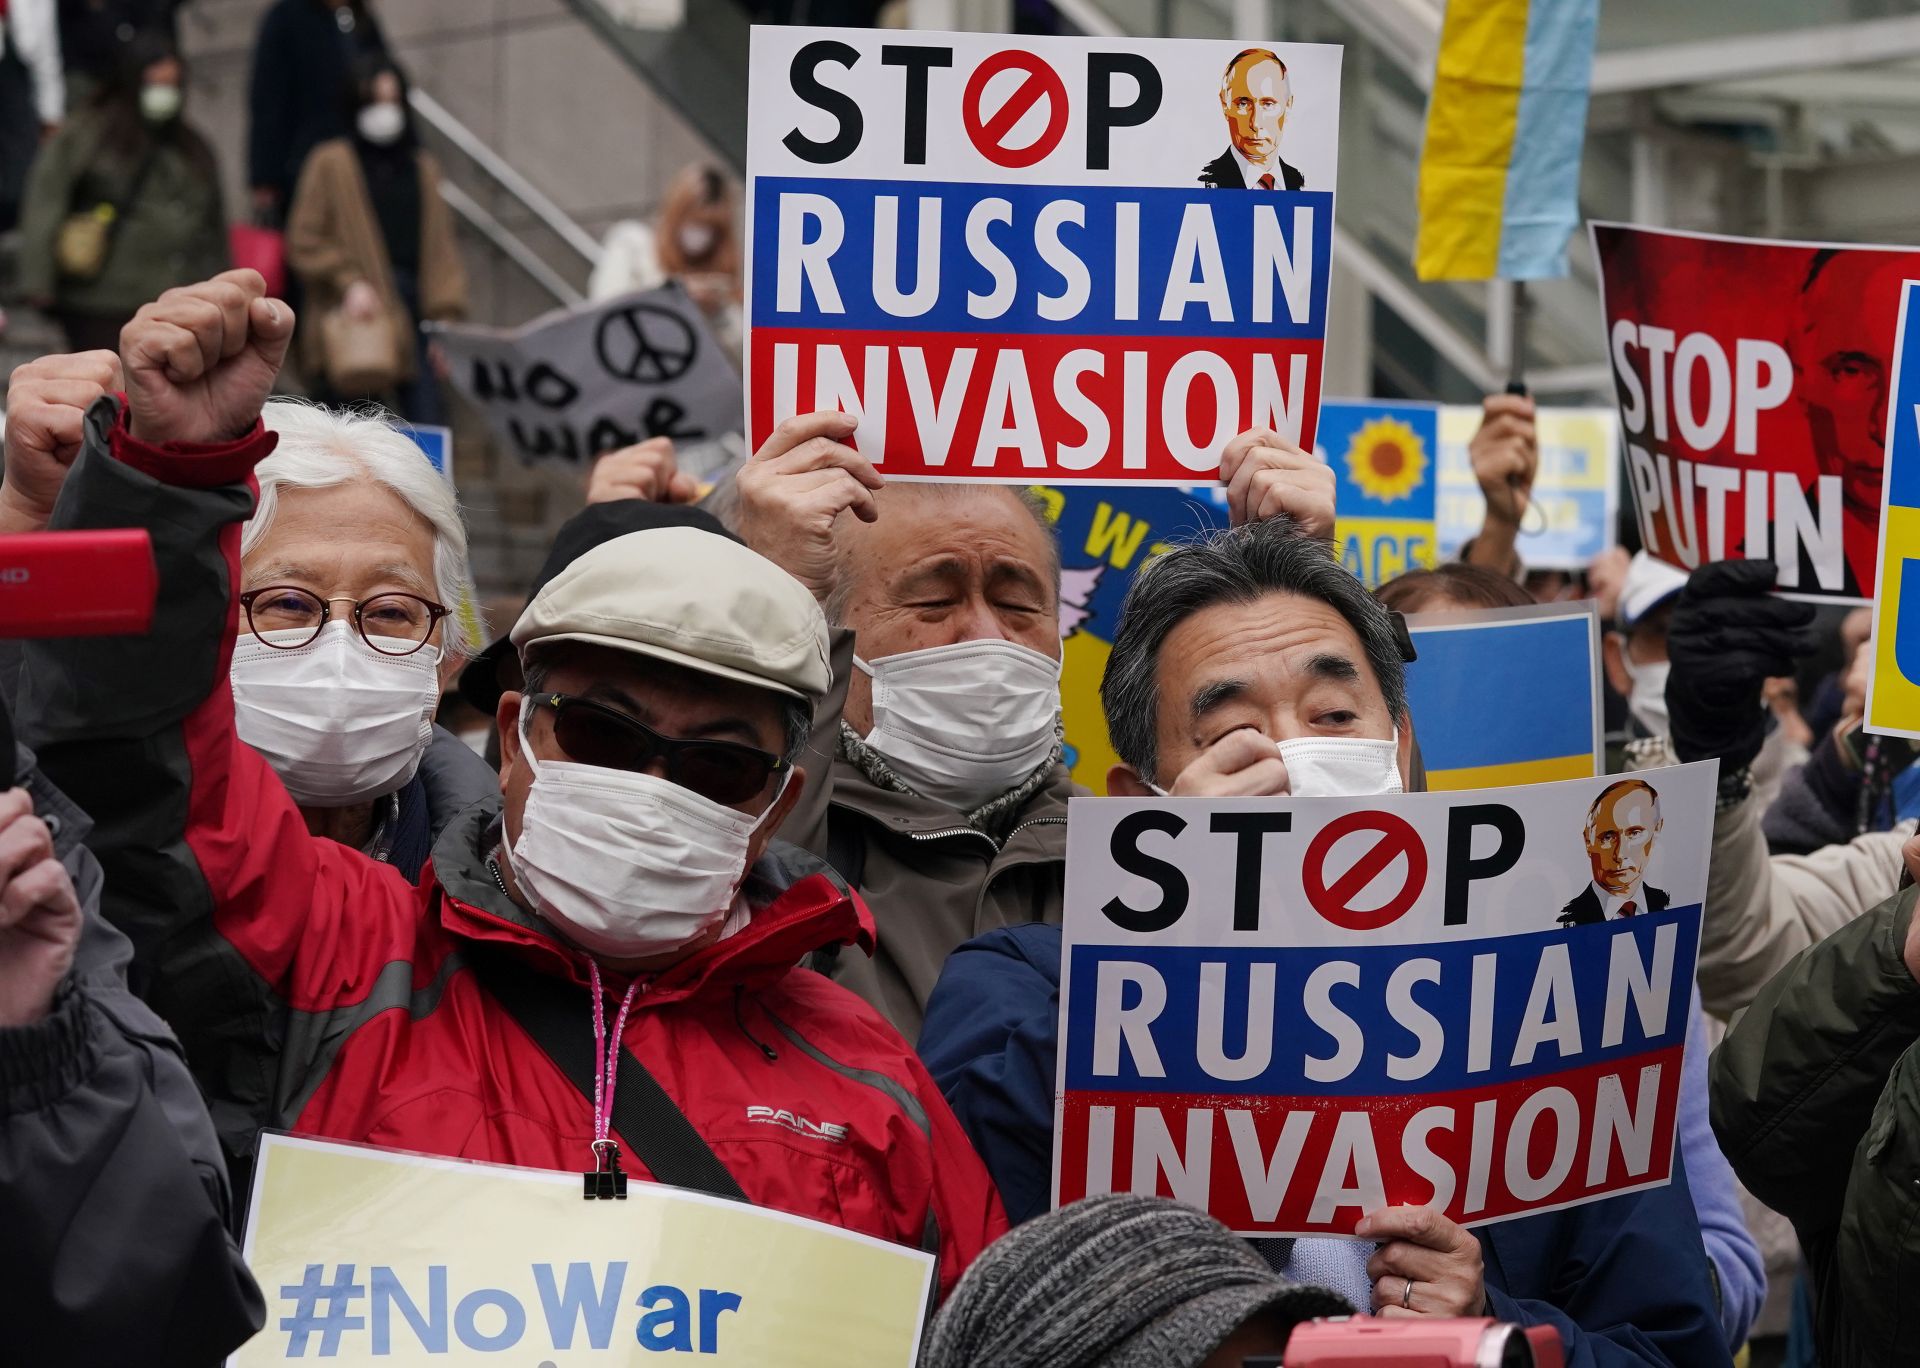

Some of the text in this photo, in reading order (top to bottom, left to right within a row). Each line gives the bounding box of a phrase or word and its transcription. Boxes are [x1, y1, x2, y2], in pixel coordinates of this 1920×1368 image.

[782, 40, 1163, 170] STOP
[776, 192, 1314, 324] RUSSIAN
[471, 354, 580, 410] NO
[773, 342, 1308, 472] INVASION
[1611, 318, 1794, 456] STOP
[1631, 444, 1844, 591] PUTIN
[1101, 803, 1526, 933] STOP
[1092, 923, 1678, 1083] RUSSIAN
[1084, 1062, 1662, 1224] INVASION
[279, 1261, 743, 1359] #NoWar
